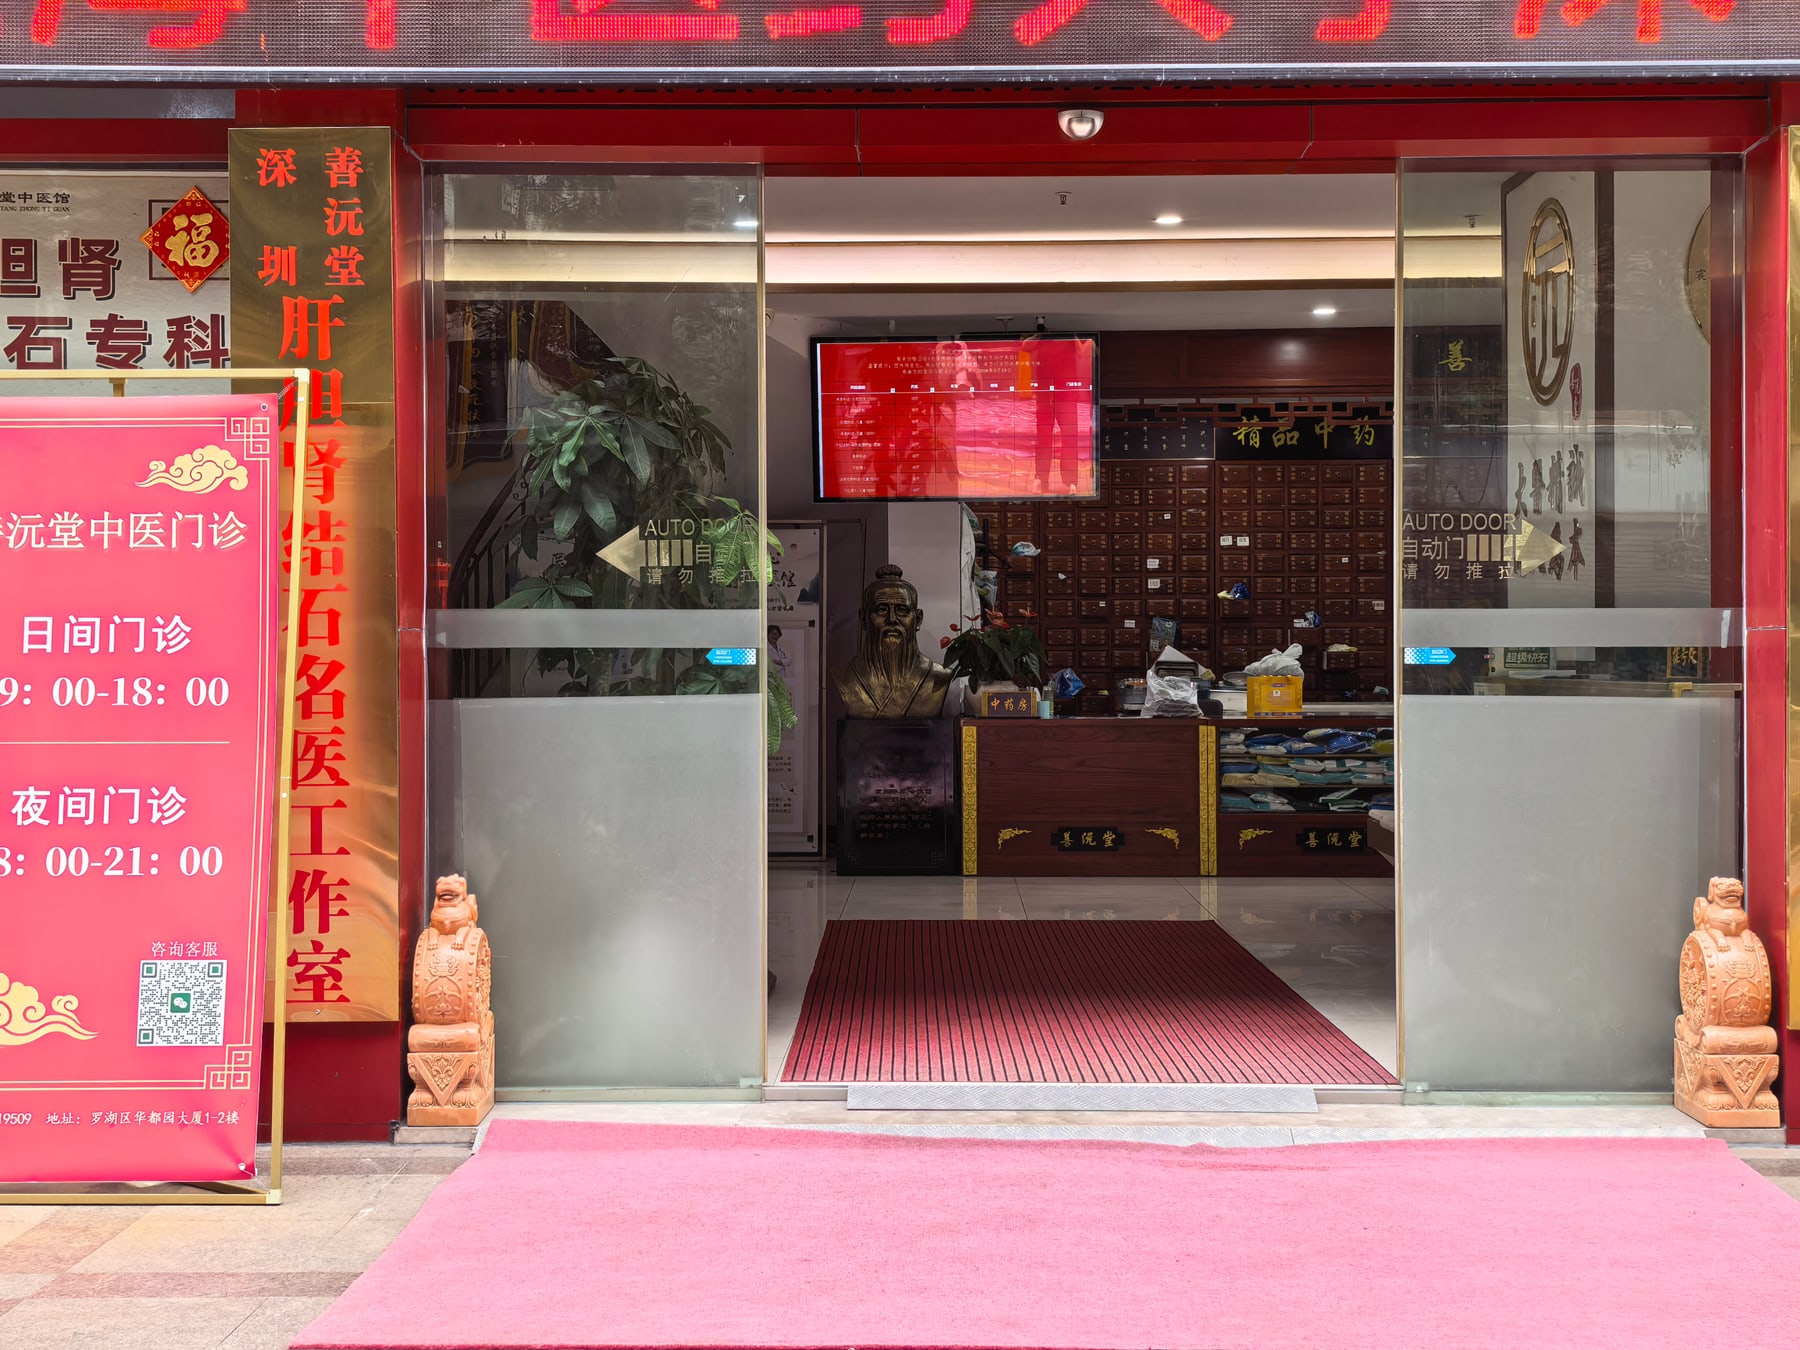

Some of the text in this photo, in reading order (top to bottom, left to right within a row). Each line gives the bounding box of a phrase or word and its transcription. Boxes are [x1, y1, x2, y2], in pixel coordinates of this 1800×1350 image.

[0, 192, 70, 204] 堂中医馆
[324, 147, 365, 287] 善沅堂
[165, 213, 219, 267] 福
[1438, 340, 1473, 372] 善
[1232, 416, 1376, 450] 精品中药
[0, 510, 247, 551] 沅堂中医门诊
[644, 519, 695, 536] AUTO
[1402, 514, 1516, 531] AUTO DOOR
[1402, 536, 1464, 560] 自动门
[1402, 563, 1516, 580] 请勿推拉
[22, 615, 192, 654] 日间门诊
[277, 294, 351, 1004] 肝胆肾结石名医工作室
[990, 697, 1028, 712] 中药房
[11, 786, 188, 826] 夜间门诊
[1060, 831, 1116, 848] 善沅堂
[1305, 831, 1363, 848] 善沅堂
[151, 941, 219, 957] 咨询客服
